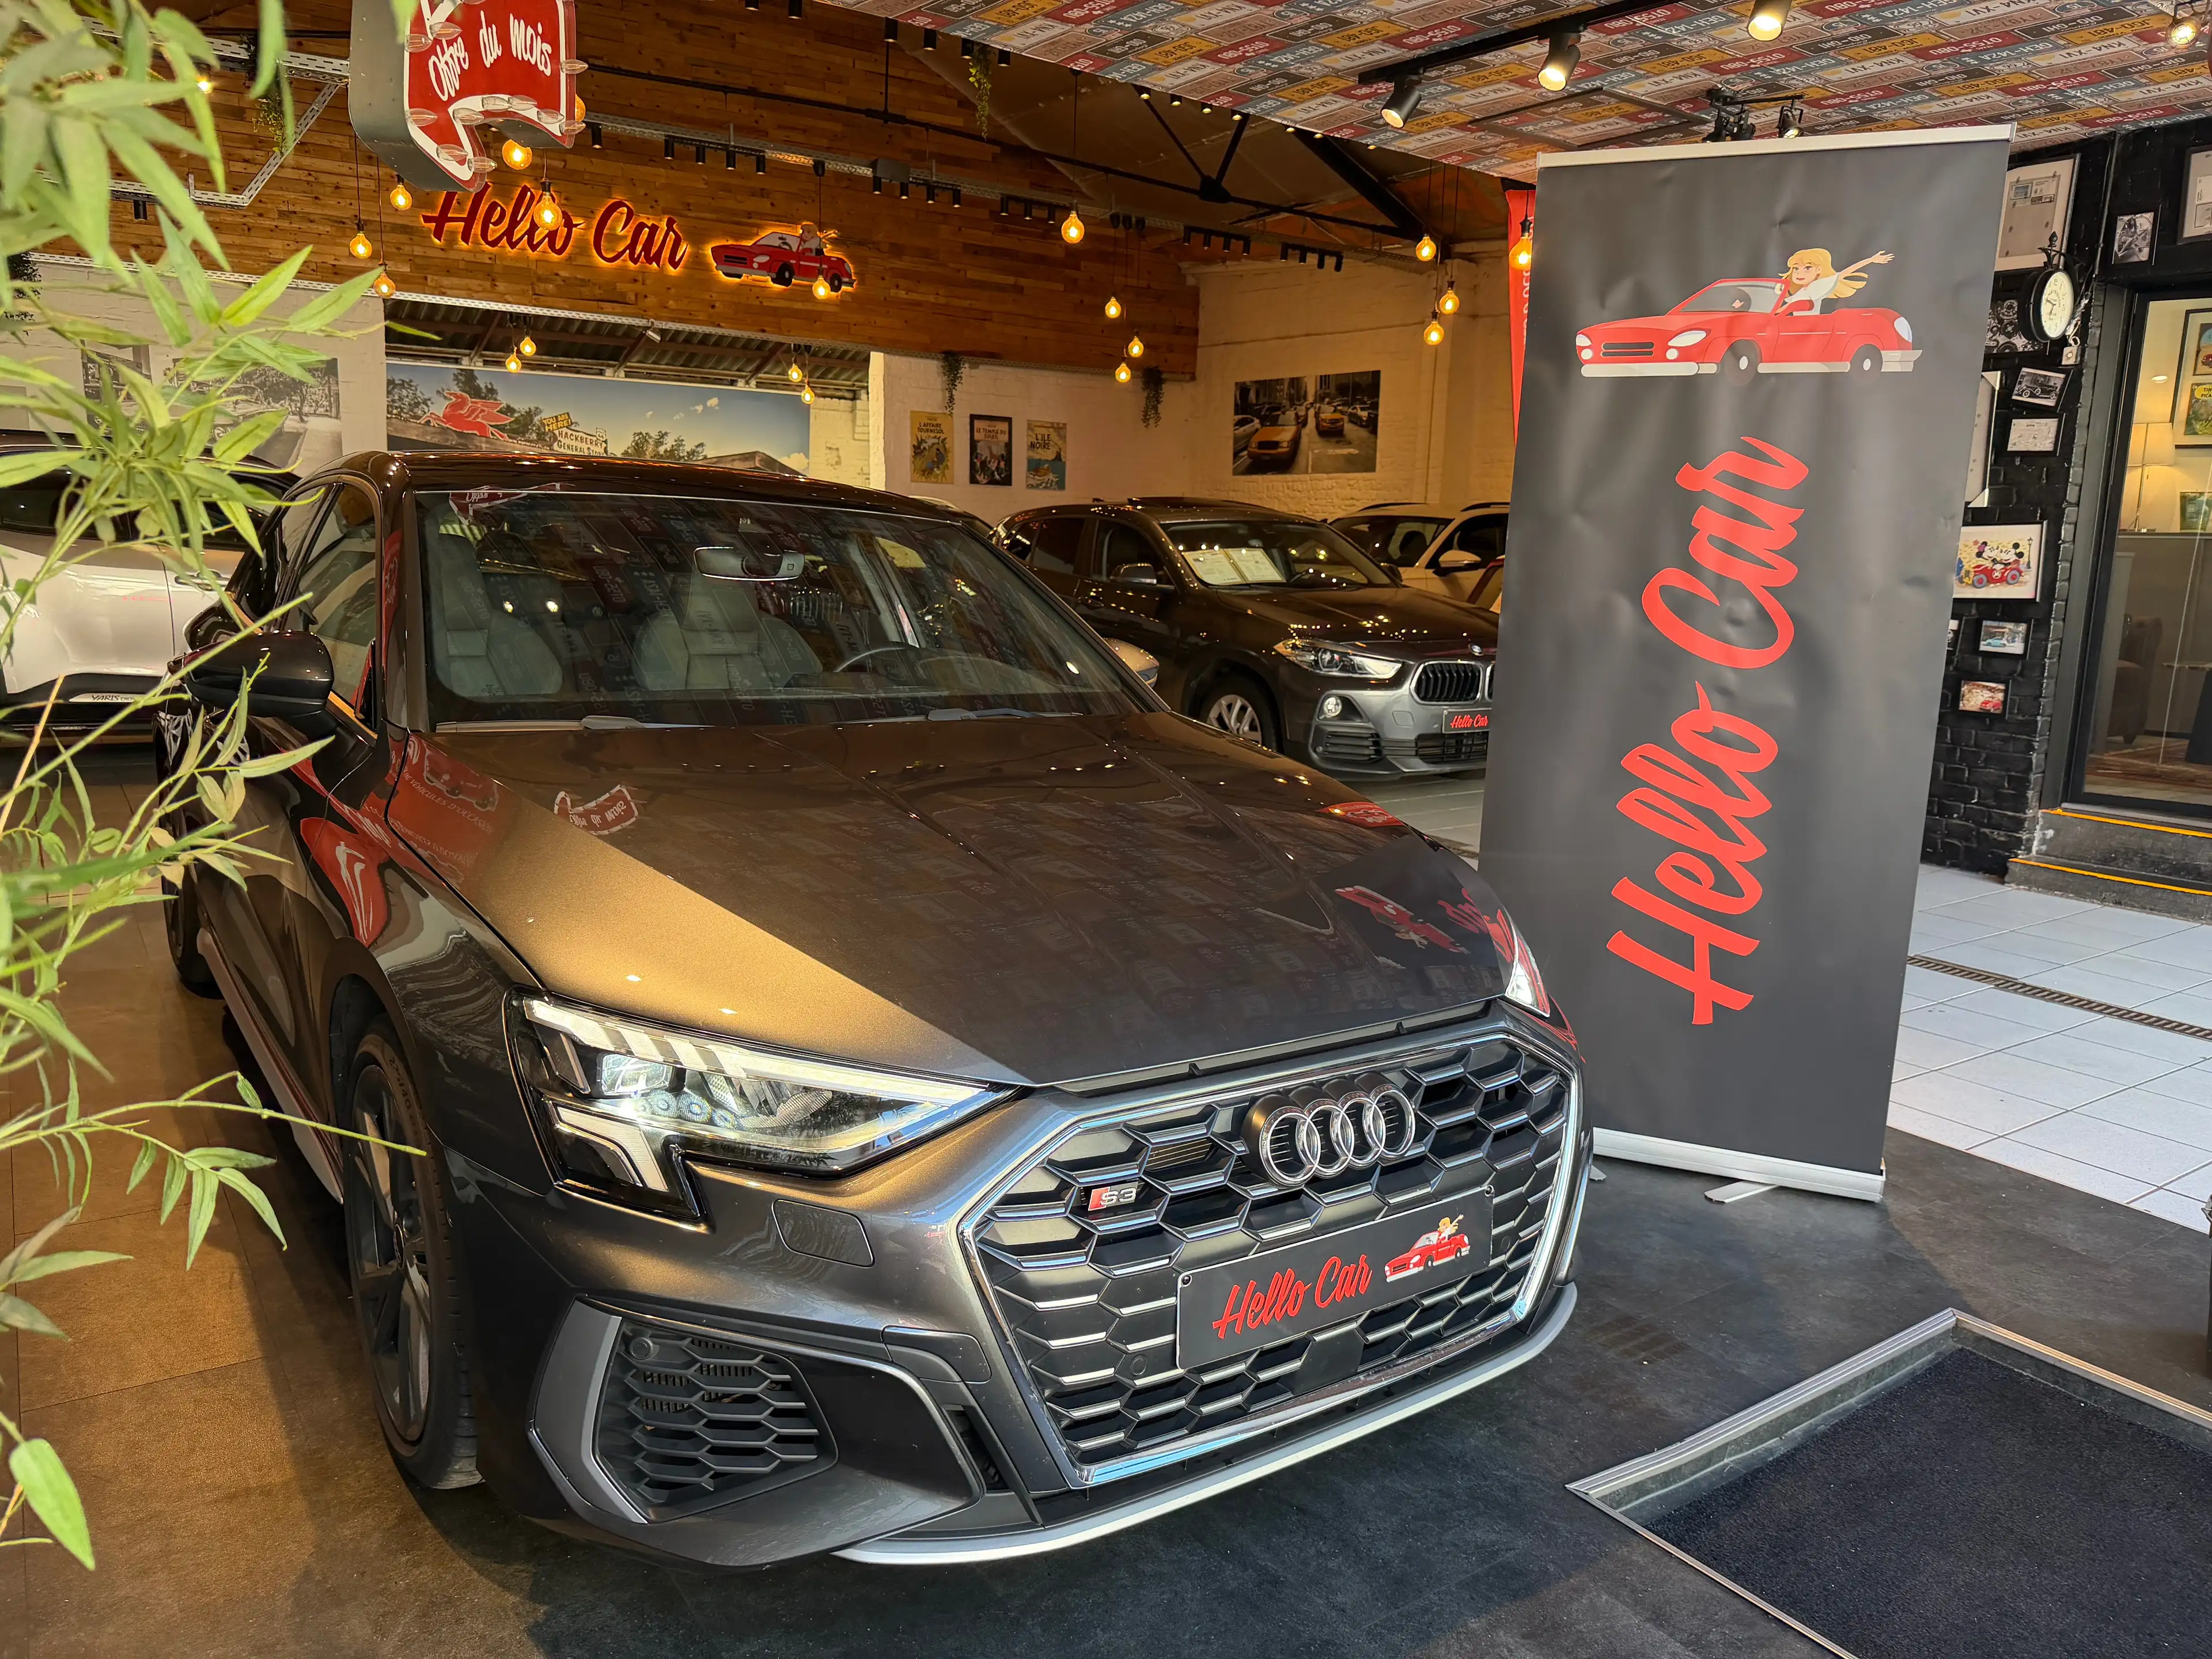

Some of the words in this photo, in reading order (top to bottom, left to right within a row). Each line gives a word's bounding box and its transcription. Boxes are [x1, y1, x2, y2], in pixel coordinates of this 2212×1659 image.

[429, 36, 469, 101] Offre
[479, 10, 502, 68] du
[509, 13, 552, 77] mois
[422, 181, 586, 256] Hello
[593, 200, 689, 270] Car
[543, 416, 556, 425] YOU
[545, 419, 571, 431] HERE!
[558, 430, 603, 449] HACKBERRY
[1030, 441, 1051, 450] NOIRE
[1641, 436, 1809, 669] Car
[1450, 715, 1474, 729] Hello
[1474, 714, 1488, 728] Car
[1605, 680, 1778, 1024] Hello
[1100, 1187, 1137, 1206] S3
[1212, 1268, 1312, 1339] Hello
[1314, 1253, 1373, 1308] Car
